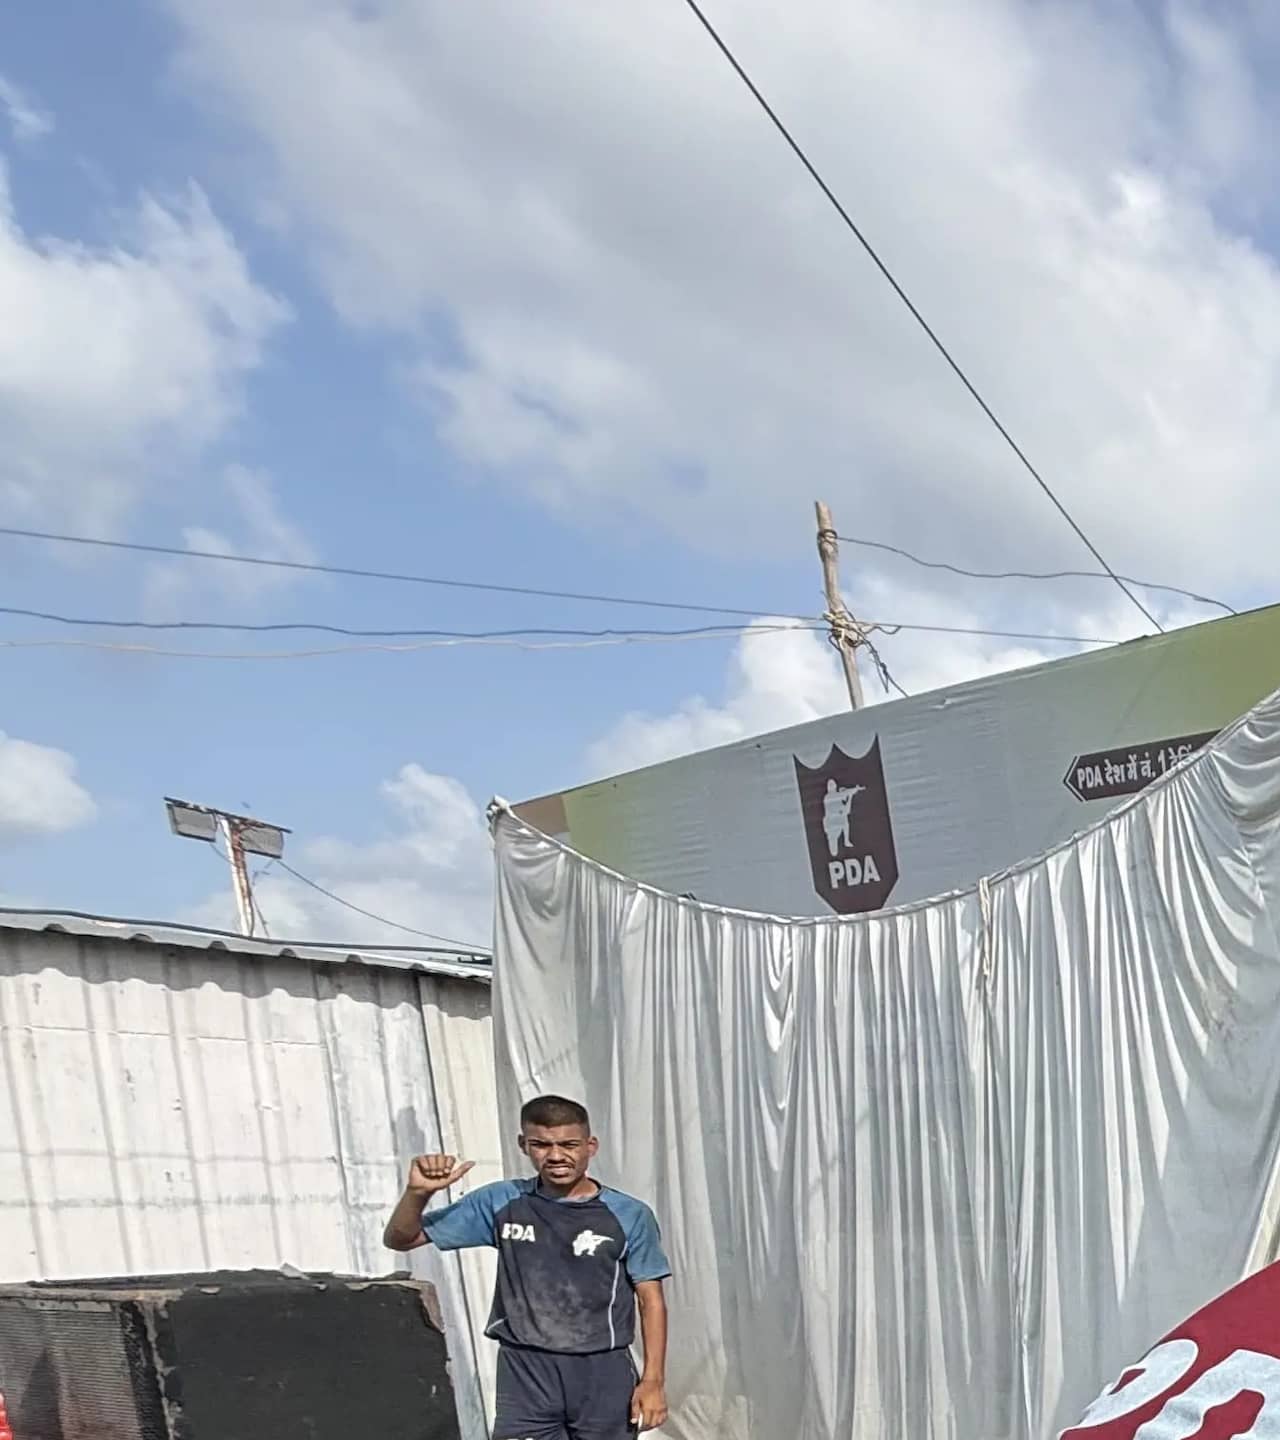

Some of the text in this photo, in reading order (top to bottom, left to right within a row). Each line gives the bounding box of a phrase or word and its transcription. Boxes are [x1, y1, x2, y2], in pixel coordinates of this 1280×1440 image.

[1077, 765, 1104, 790] PDA
[1104, 759, 1126, 785] देश
[1126, 753, 1139, 781] में
[828, 854, 881, 889] PDA
